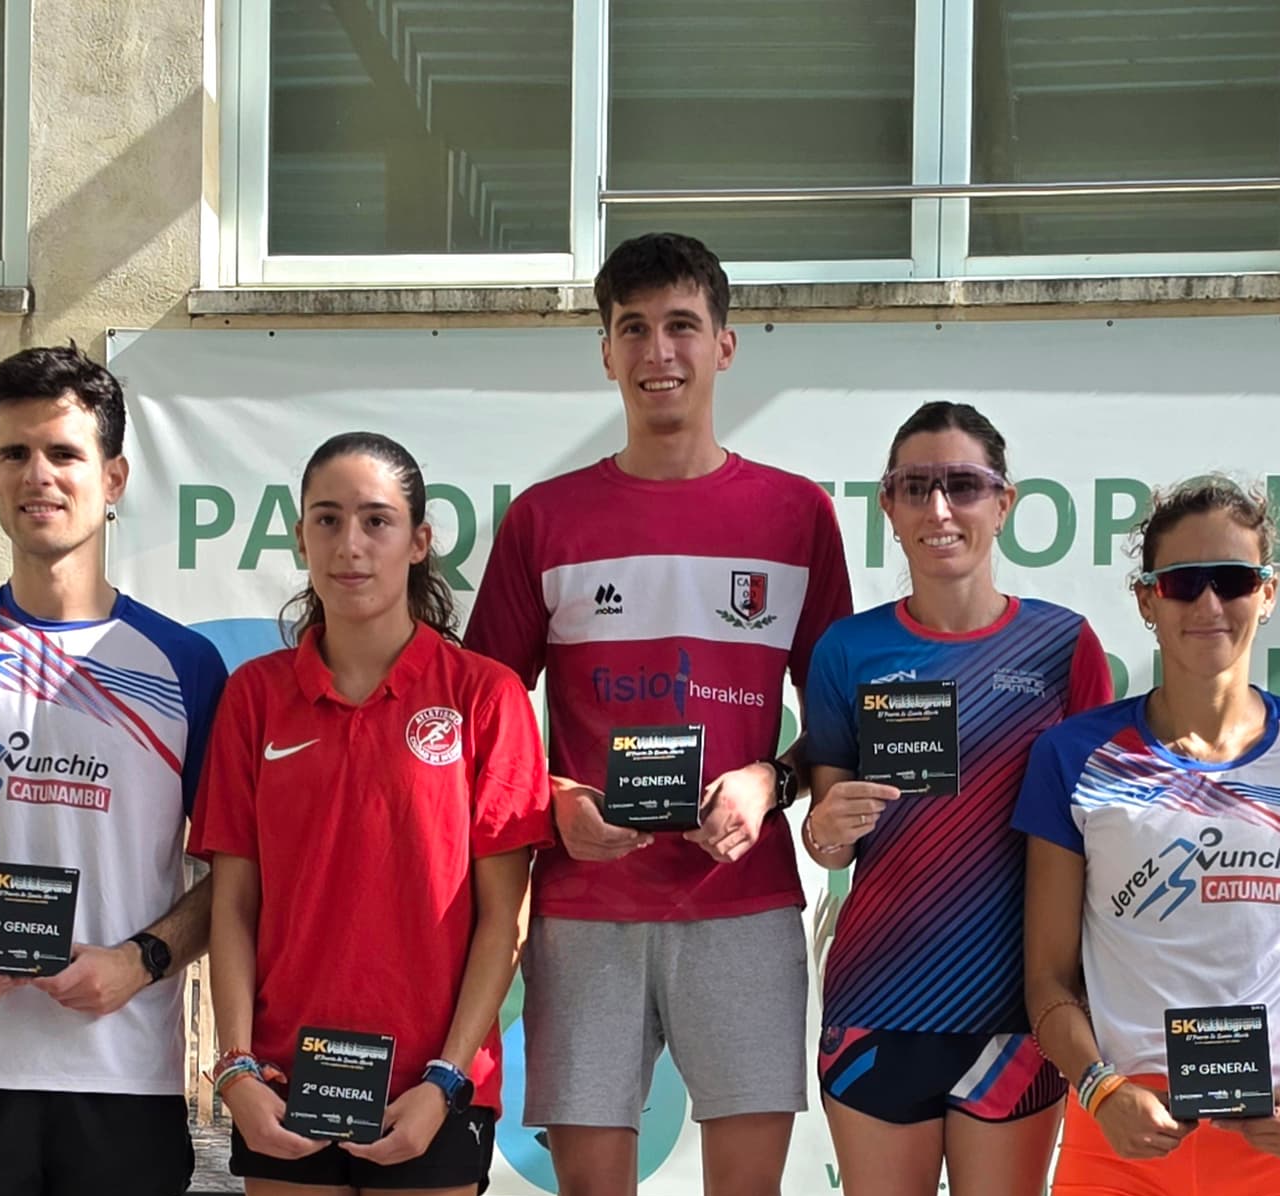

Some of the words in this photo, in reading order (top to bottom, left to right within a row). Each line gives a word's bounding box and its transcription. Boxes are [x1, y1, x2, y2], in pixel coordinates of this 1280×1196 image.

[689, 680, 764, 706] herakles
[863, 694, 889, 710] 5K
[612, 736, 638, 751] 5K
[887, 741, 944, 754] GENERAL
[631, 774, 687, 787] GENERAL
[1111, 858, 1160, 918] Jerez
[3, 921, 60, 936] GENERAL
[1171, 1018, 1197, 1034] 5K
[301, 1036, 328, 1053] 5K
[1199, 1061, 1259, 1075] GENERAL
[319, 1084, 374, 1102] GENERAL
